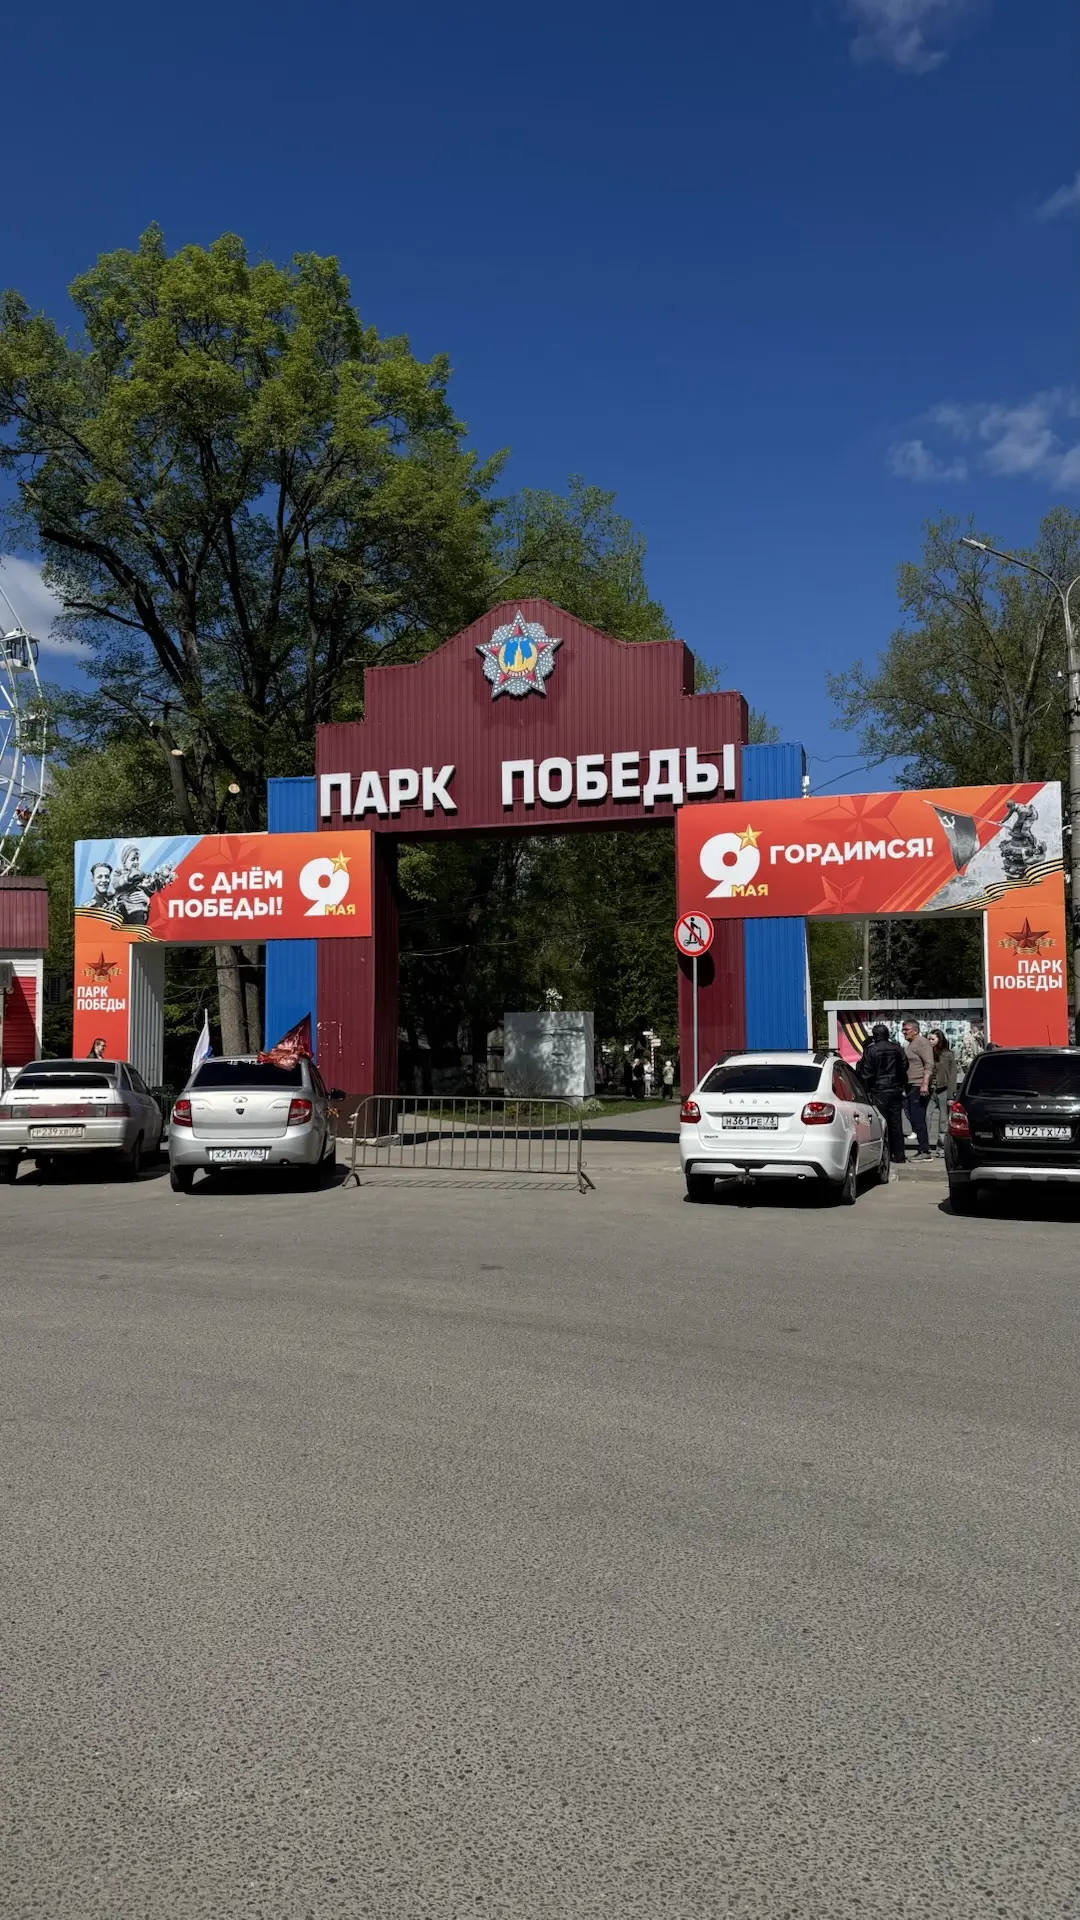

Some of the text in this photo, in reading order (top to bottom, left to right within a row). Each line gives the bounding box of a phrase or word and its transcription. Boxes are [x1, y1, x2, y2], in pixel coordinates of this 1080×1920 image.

[320, 744, 735, 817] ПАРК ПОБЕДЫ
[769, 837, 934, 866] ГОРДИМСЯ!
[699, 832, 761, 898] 9
[188, 866, 283, 894] С ДНЁМ
[299, 857, 350, 917] 9
[731, 883, 769, 897] МАЯ
[168, 896, 283, 920] ПОБЕДЫ!
[324, 903, 356, 916] МАЯ
[1018, 959, 1063, 974] ПАРК
[77, 986, 108, 998] ПАРК
[993, 974, 1063, 992] ПОБЕДЫ
[77, 998, 126, 1013] ПОБЕДЫ
